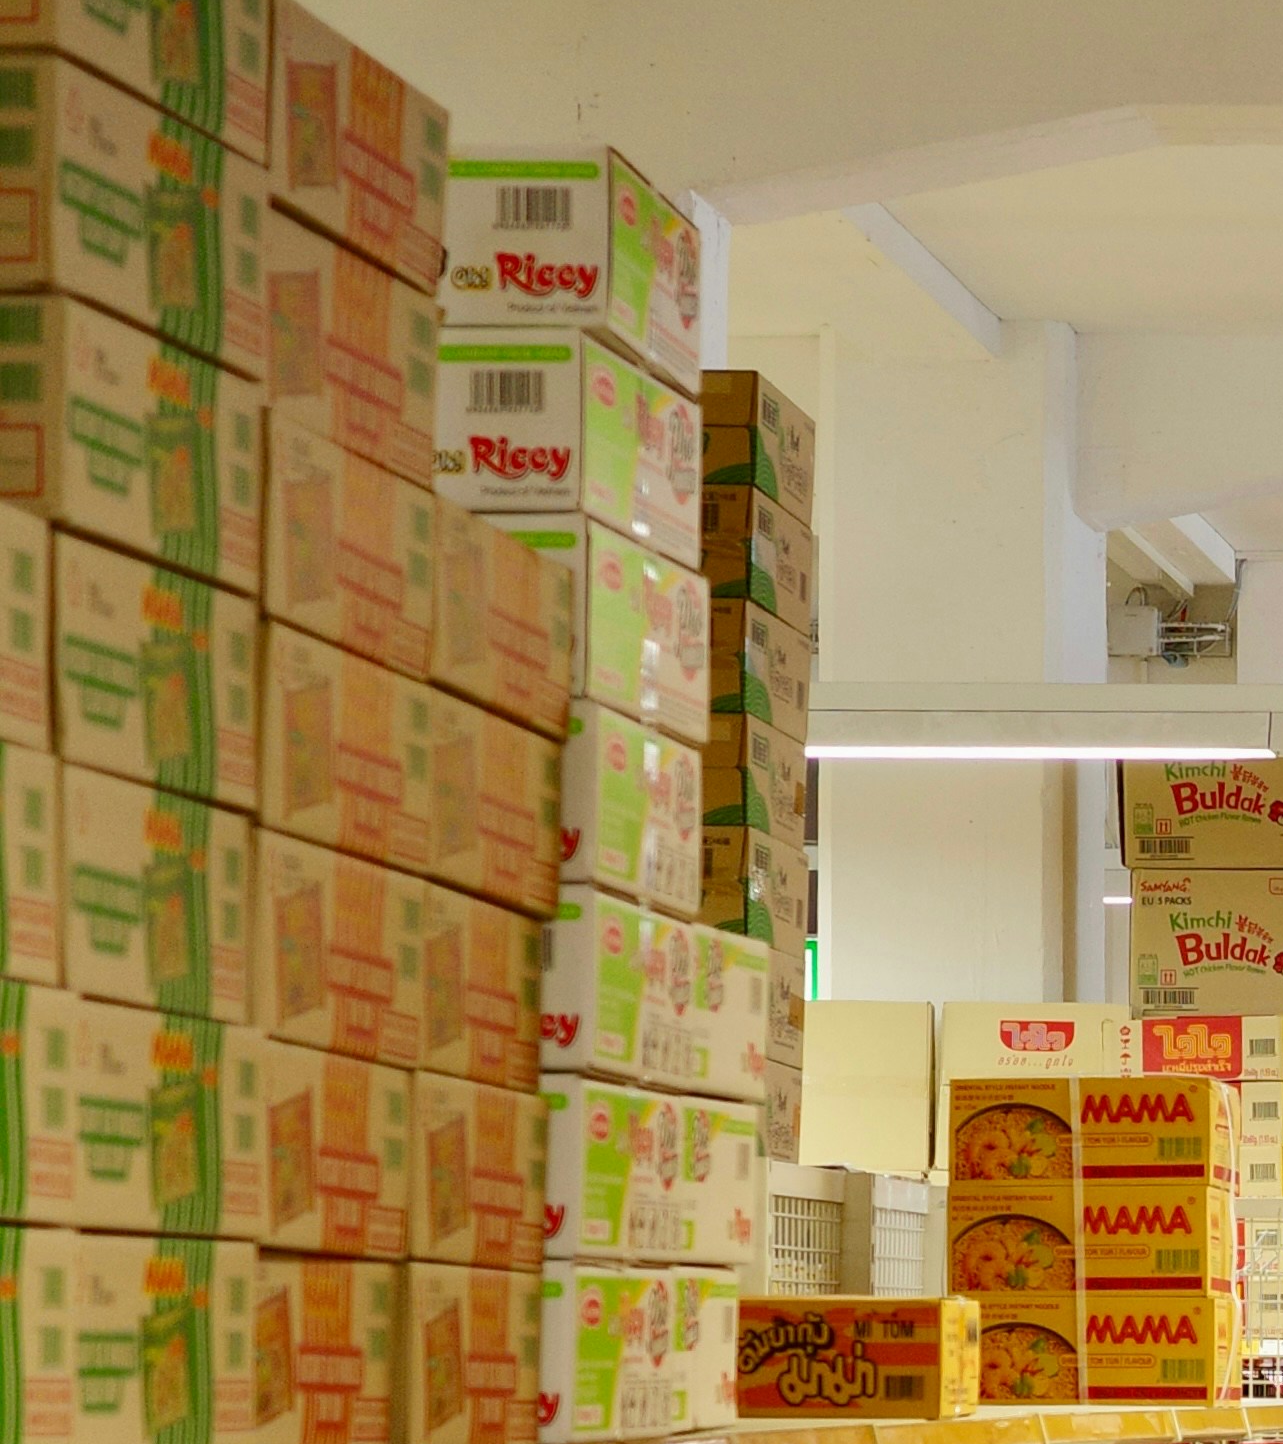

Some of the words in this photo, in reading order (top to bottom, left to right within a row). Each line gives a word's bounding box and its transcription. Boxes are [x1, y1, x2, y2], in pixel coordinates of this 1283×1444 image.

[494, 252, 599, 298] Riccy
[468, 435, 571, 481] Riccy
[1165, 761, 1227, 781] Kimchi
[1171, 782, 1266, 816] Buldak
[1141, 877, 1191, 892] SAMYANG
[1142, 897, 1153, 905] EU
[1157, 897, 1162, 905] 5
[1164, 897, 1191, 905] PACKS
[1169, 911, 1232, 931] Kimchi
[1176, 933, 1271, 967] Buldak
[1081, 1093, 1194, 1123] MAMA
[1084, 1205, 1192, 1235] MAMA
[1086, 1315, 1197, 1344] MAMA
[778, 1340, 878, 1406] มาม่า
